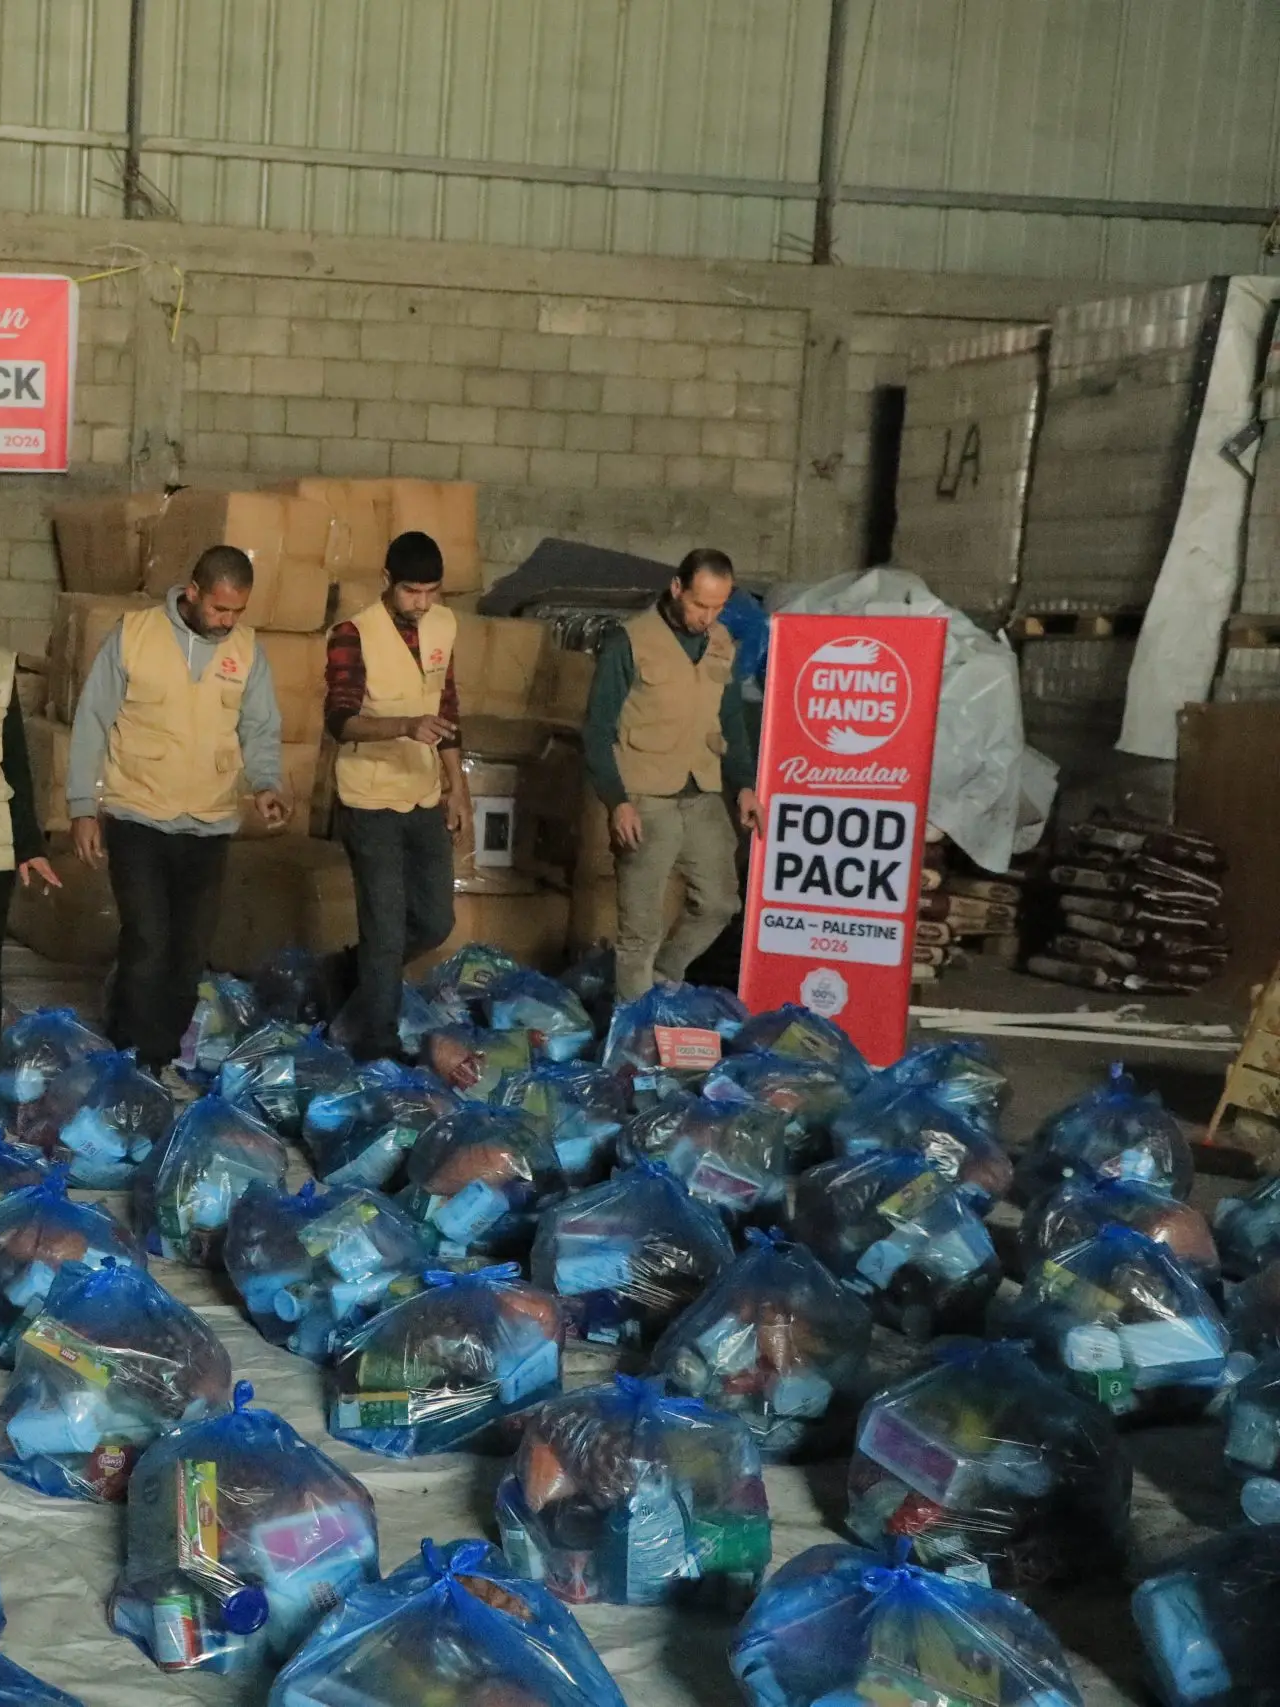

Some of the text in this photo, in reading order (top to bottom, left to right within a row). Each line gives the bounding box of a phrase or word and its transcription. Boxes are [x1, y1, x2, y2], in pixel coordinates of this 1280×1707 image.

[4, 435, 40, 448] 2026
[812, 668, 898, 694] GIVING
[807, 697, 897, 723] HANDS
[779, 755, 912, 784] Ramadan
[776, 803, 906, 851] FOOD
[774, 852, 902, 902] PACK
[764, 914, 805, 931] GAZA
[822, 919, 897, 940] PALESTINE
[809, 936, 848, 954] 2026
